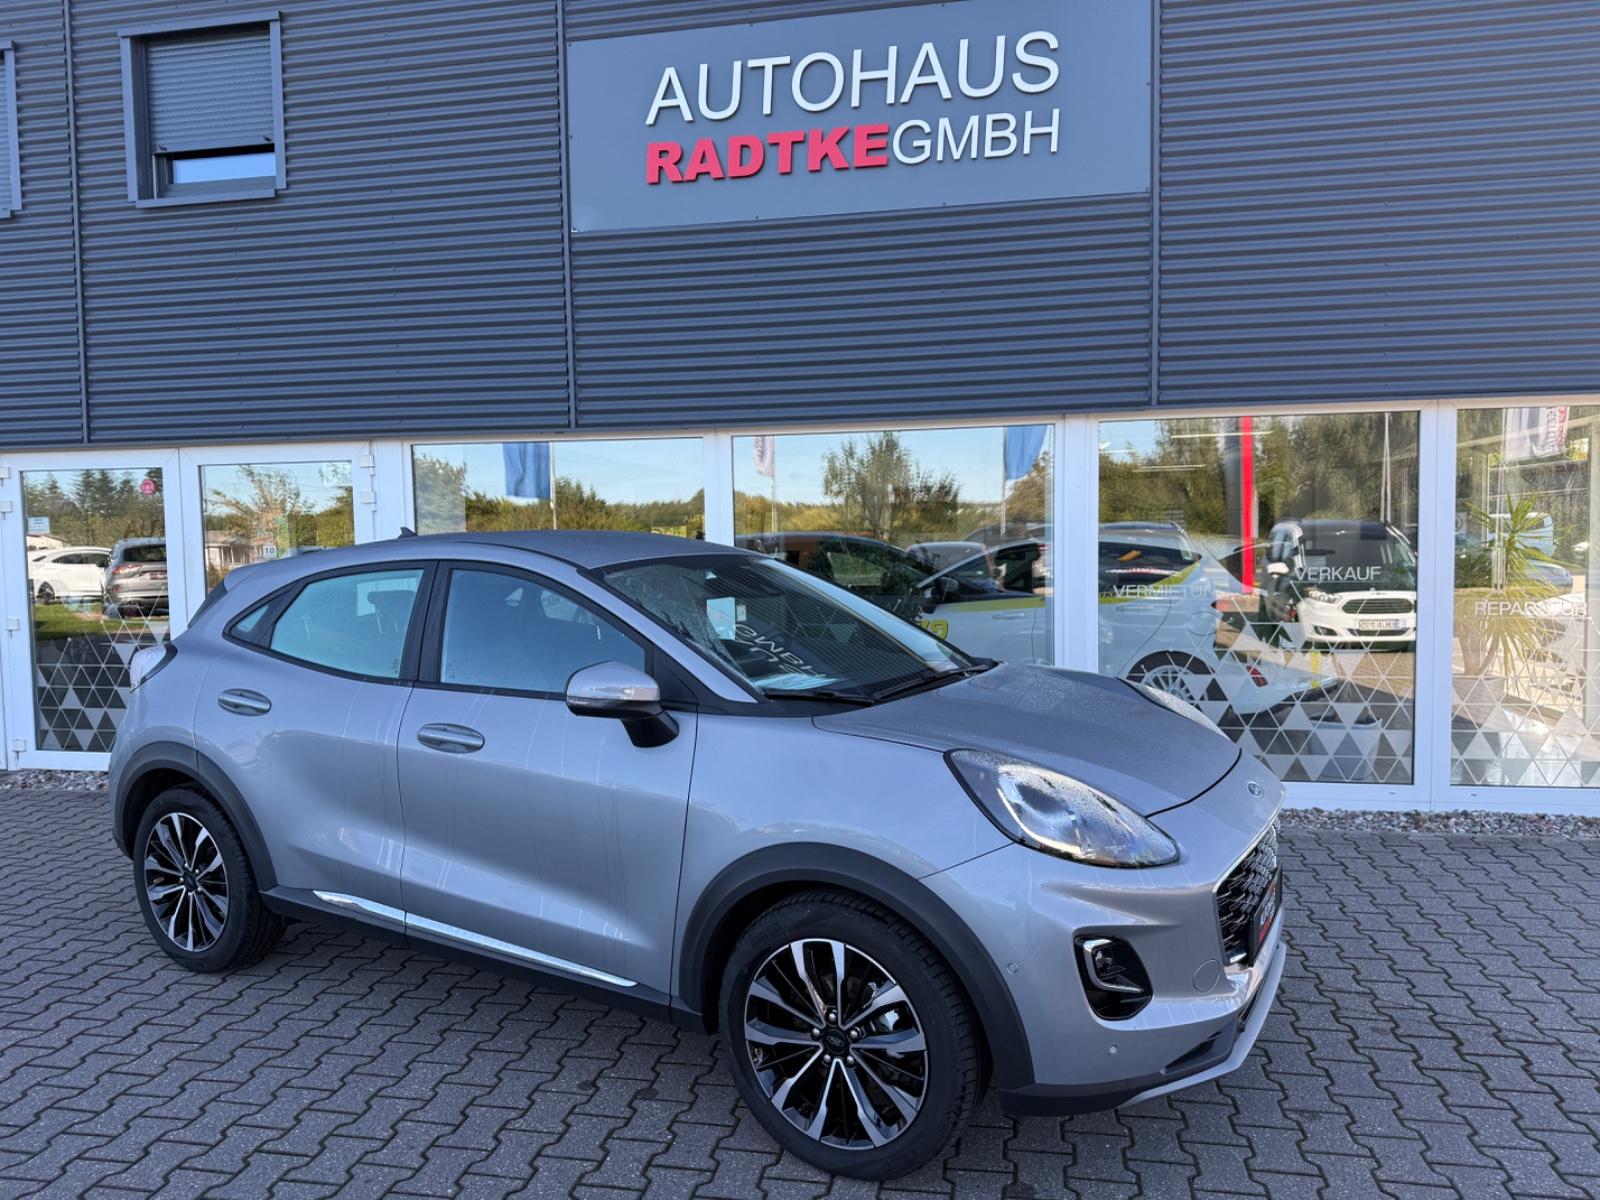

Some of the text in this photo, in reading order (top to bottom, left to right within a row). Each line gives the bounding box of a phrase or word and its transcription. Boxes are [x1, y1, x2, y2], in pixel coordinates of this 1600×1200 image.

[645, 30, 1060, 126] AUTOHAUS
[645, 108, 1061, 185] RADTKE GMBH
[1294, 565, 1382, 580] VERKAUF
